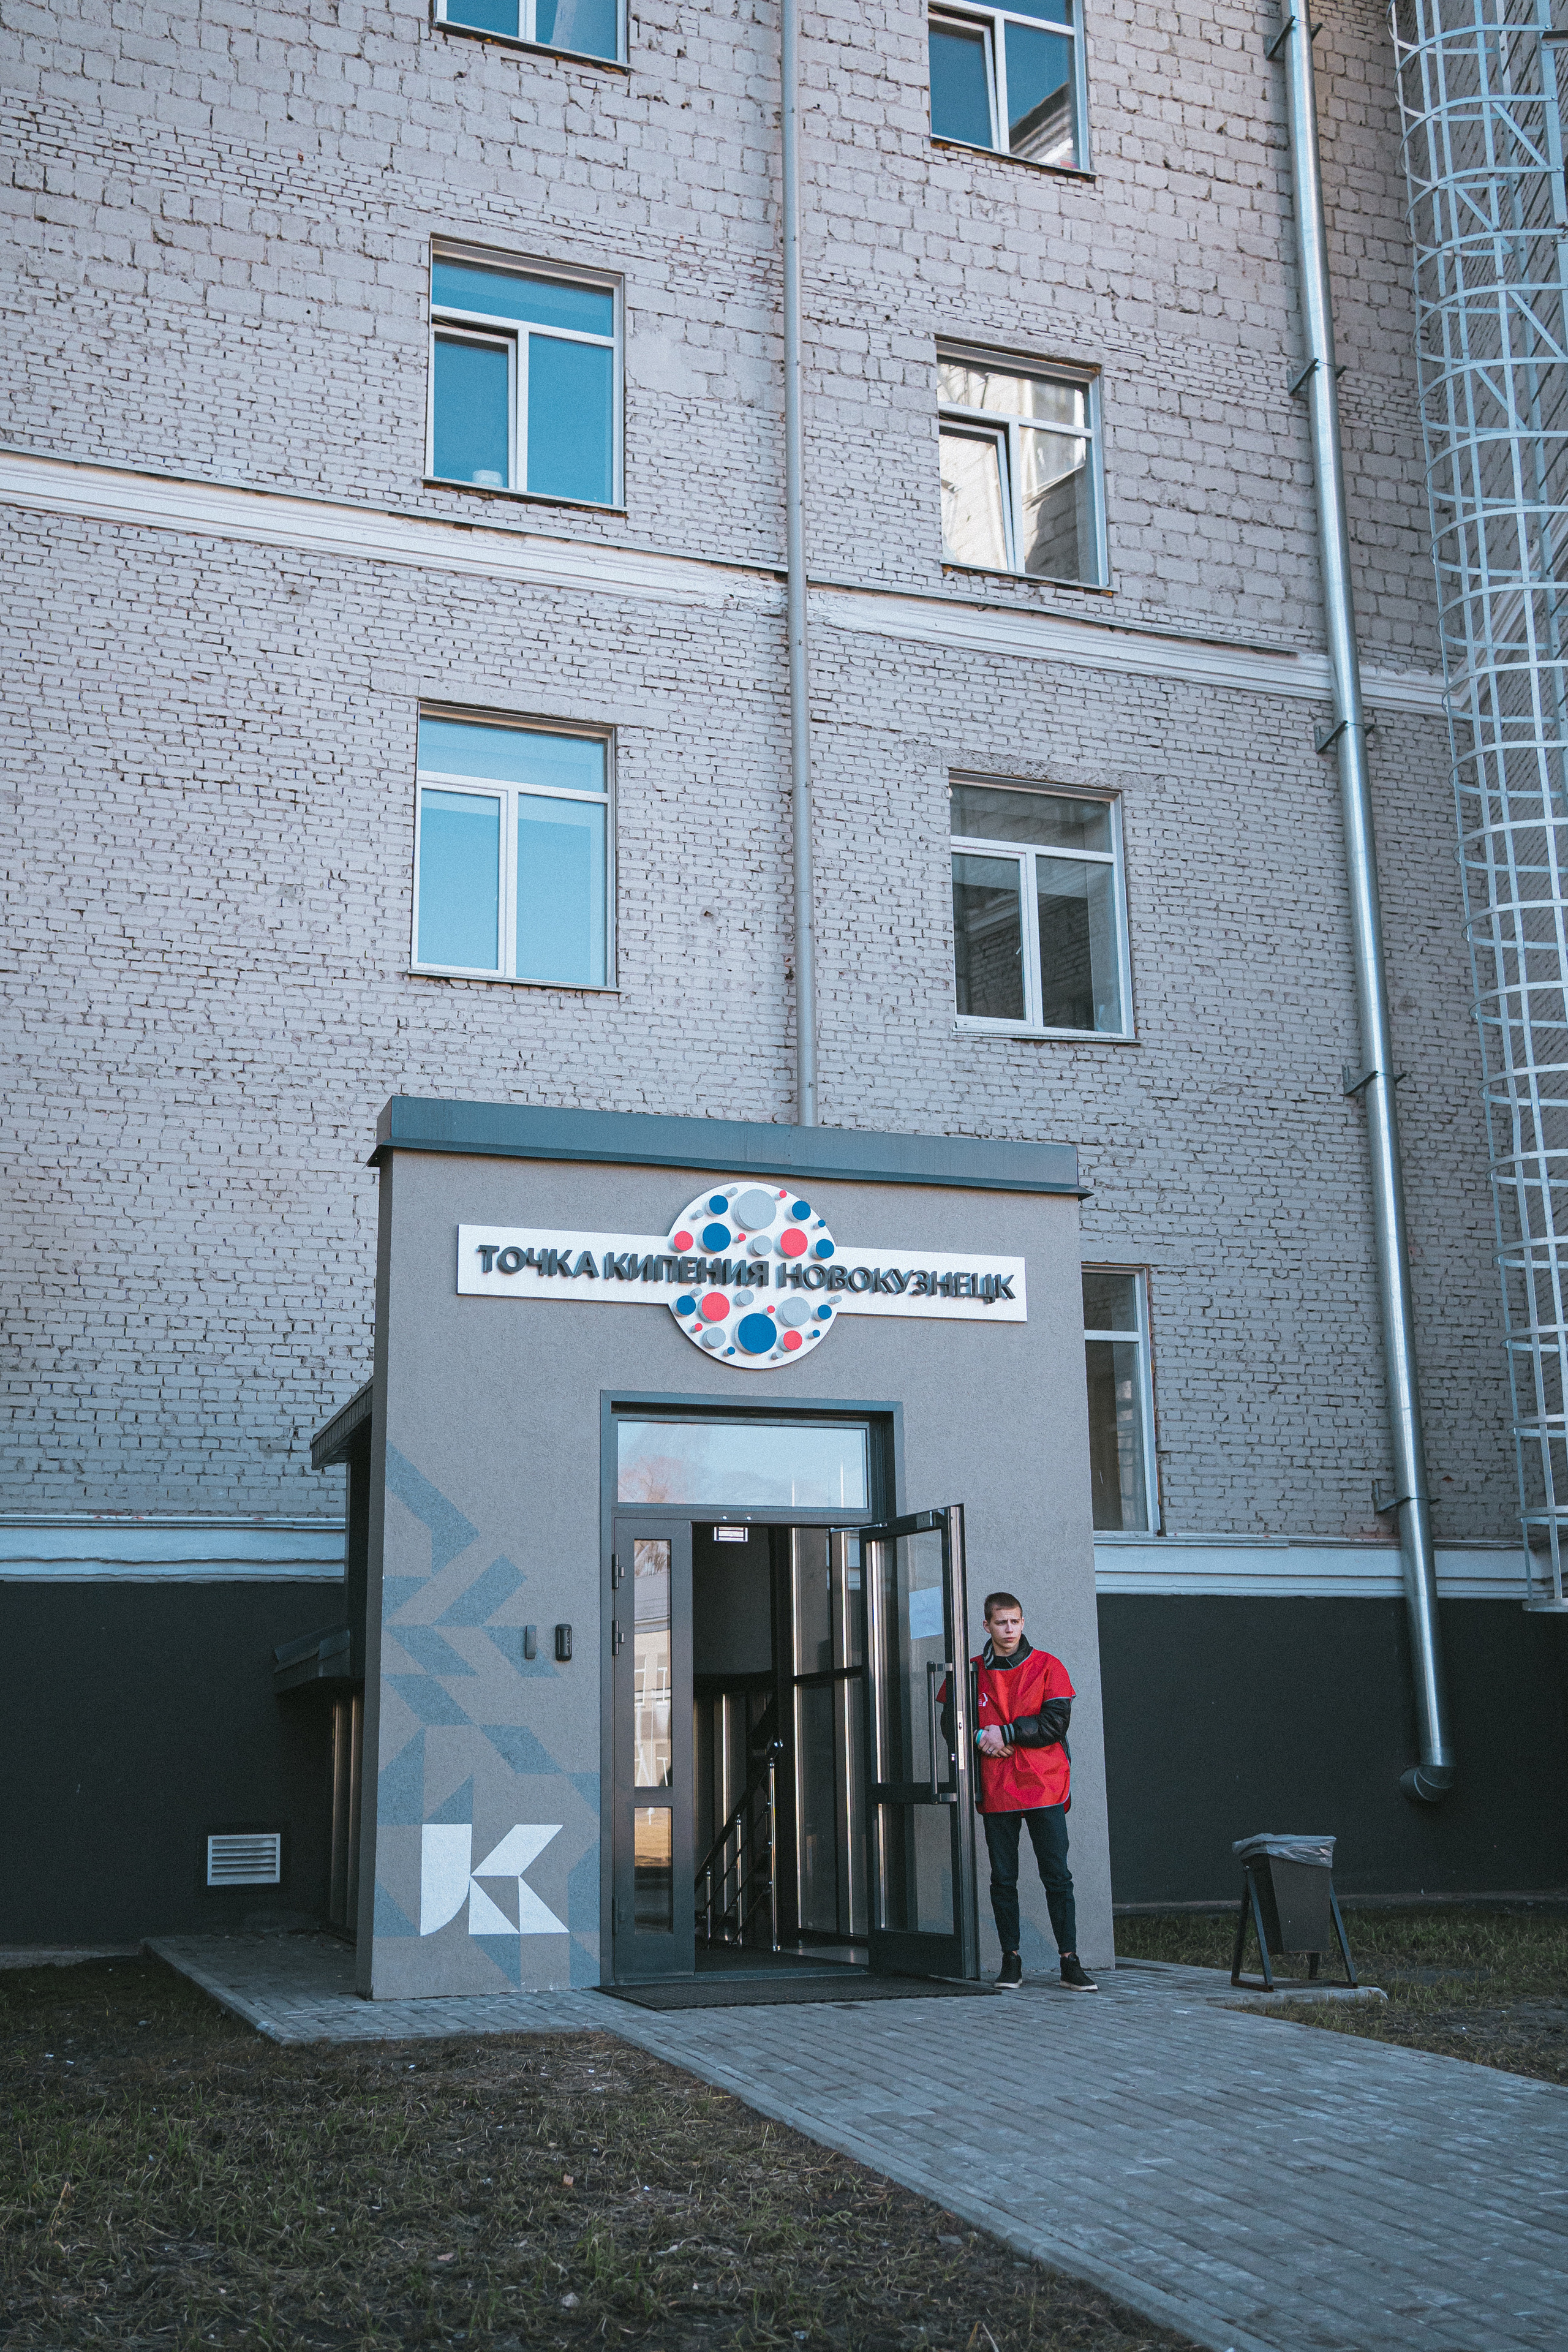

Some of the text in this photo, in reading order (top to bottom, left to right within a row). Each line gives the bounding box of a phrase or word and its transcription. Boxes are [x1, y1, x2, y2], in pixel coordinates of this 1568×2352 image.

[477, 1245, 1016, 1304] ТОЧКА КИПЕНИЯ НОВОКУЗНЕЦК
